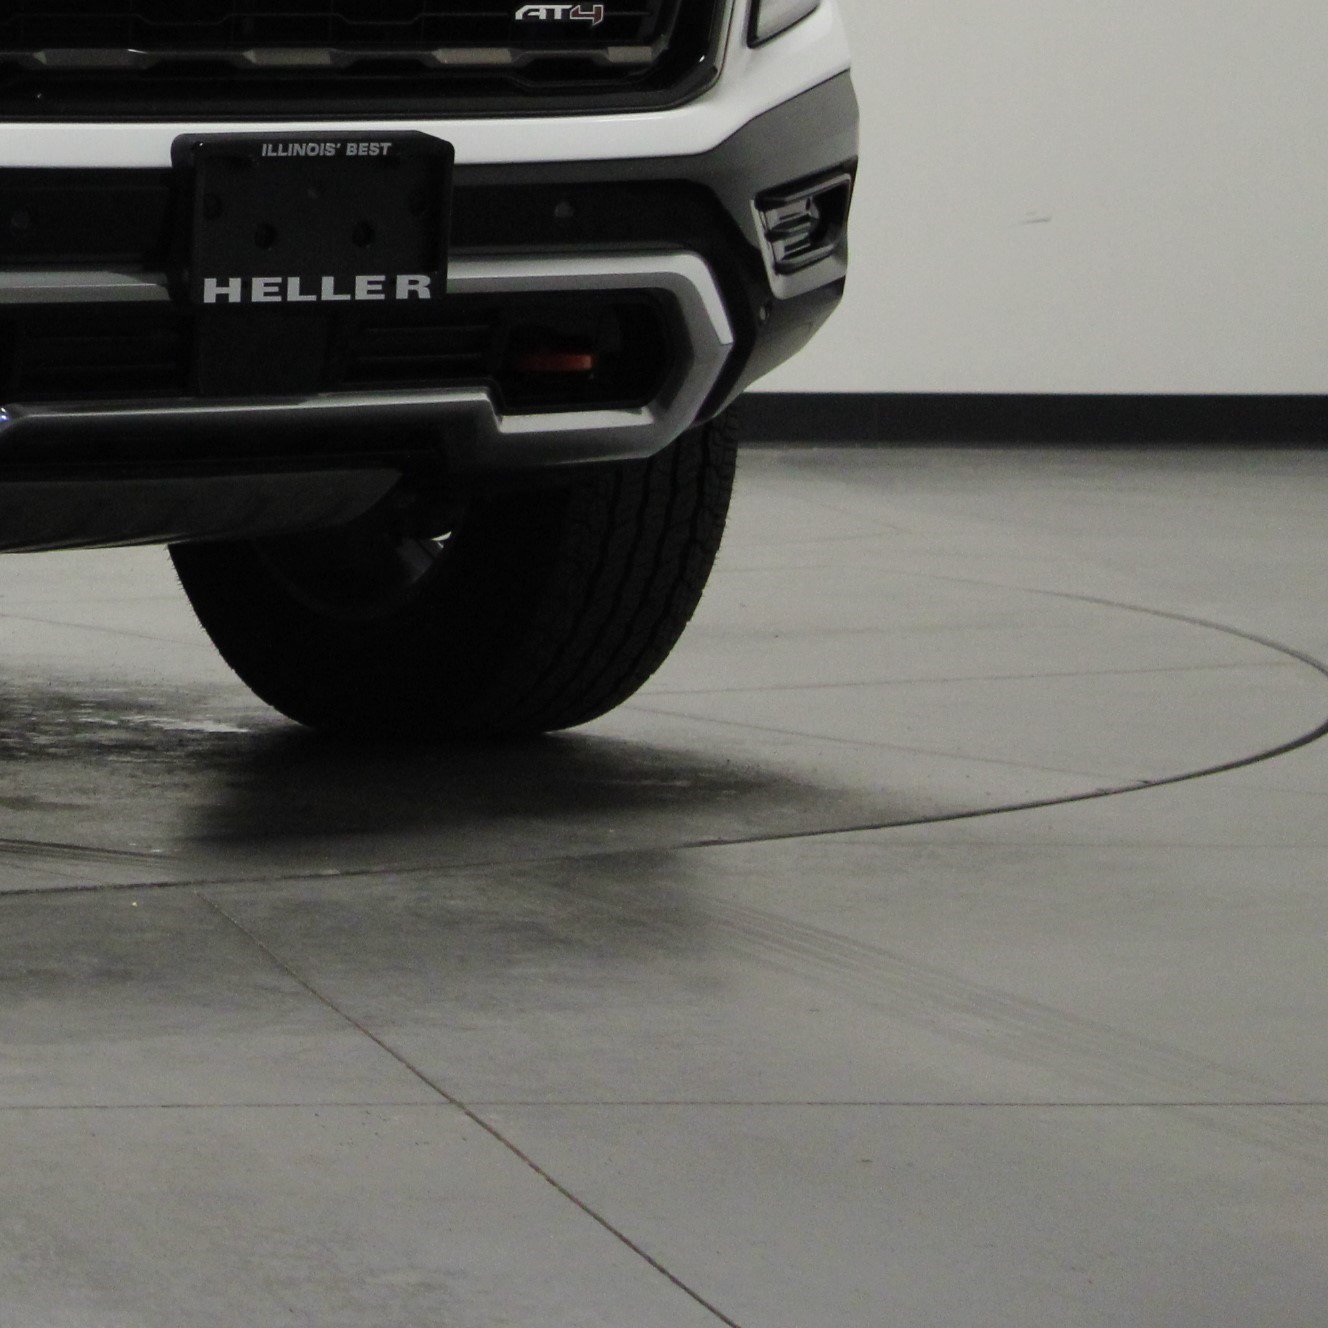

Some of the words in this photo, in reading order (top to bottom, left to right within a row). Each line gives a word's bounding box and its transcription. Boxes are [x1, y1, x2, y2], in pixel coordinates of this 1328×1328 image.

[515, 4, 604, 26] AT4
[346, 142, 393, 156] BEST
[203, 274, 432, 304] HELLER
